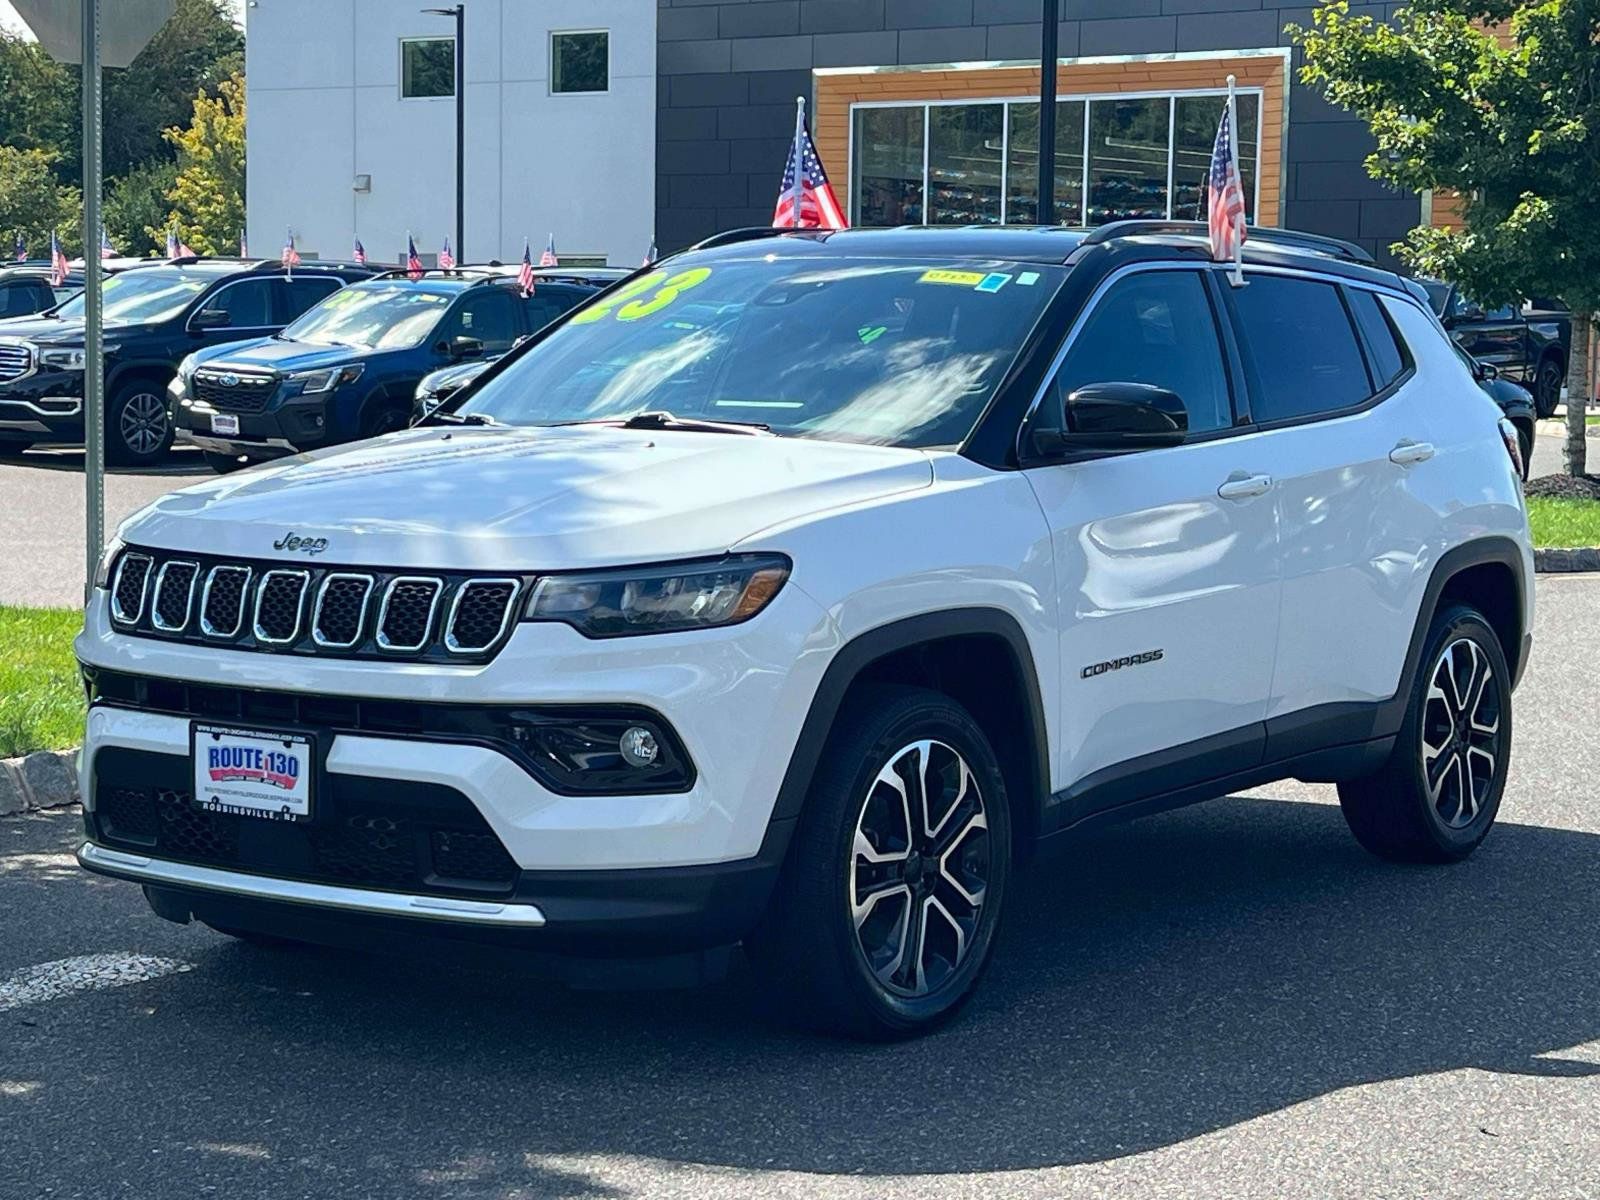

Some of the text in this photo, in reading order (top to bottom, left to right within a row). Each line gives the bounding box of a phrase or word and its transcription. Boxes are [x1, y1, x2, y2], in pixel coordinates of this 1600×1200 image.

[273, 531, 329, 556] Jeep
[1080, 648, 1164, 680] COMPASS
[209, 747, 298, 777] ROUTE 130
